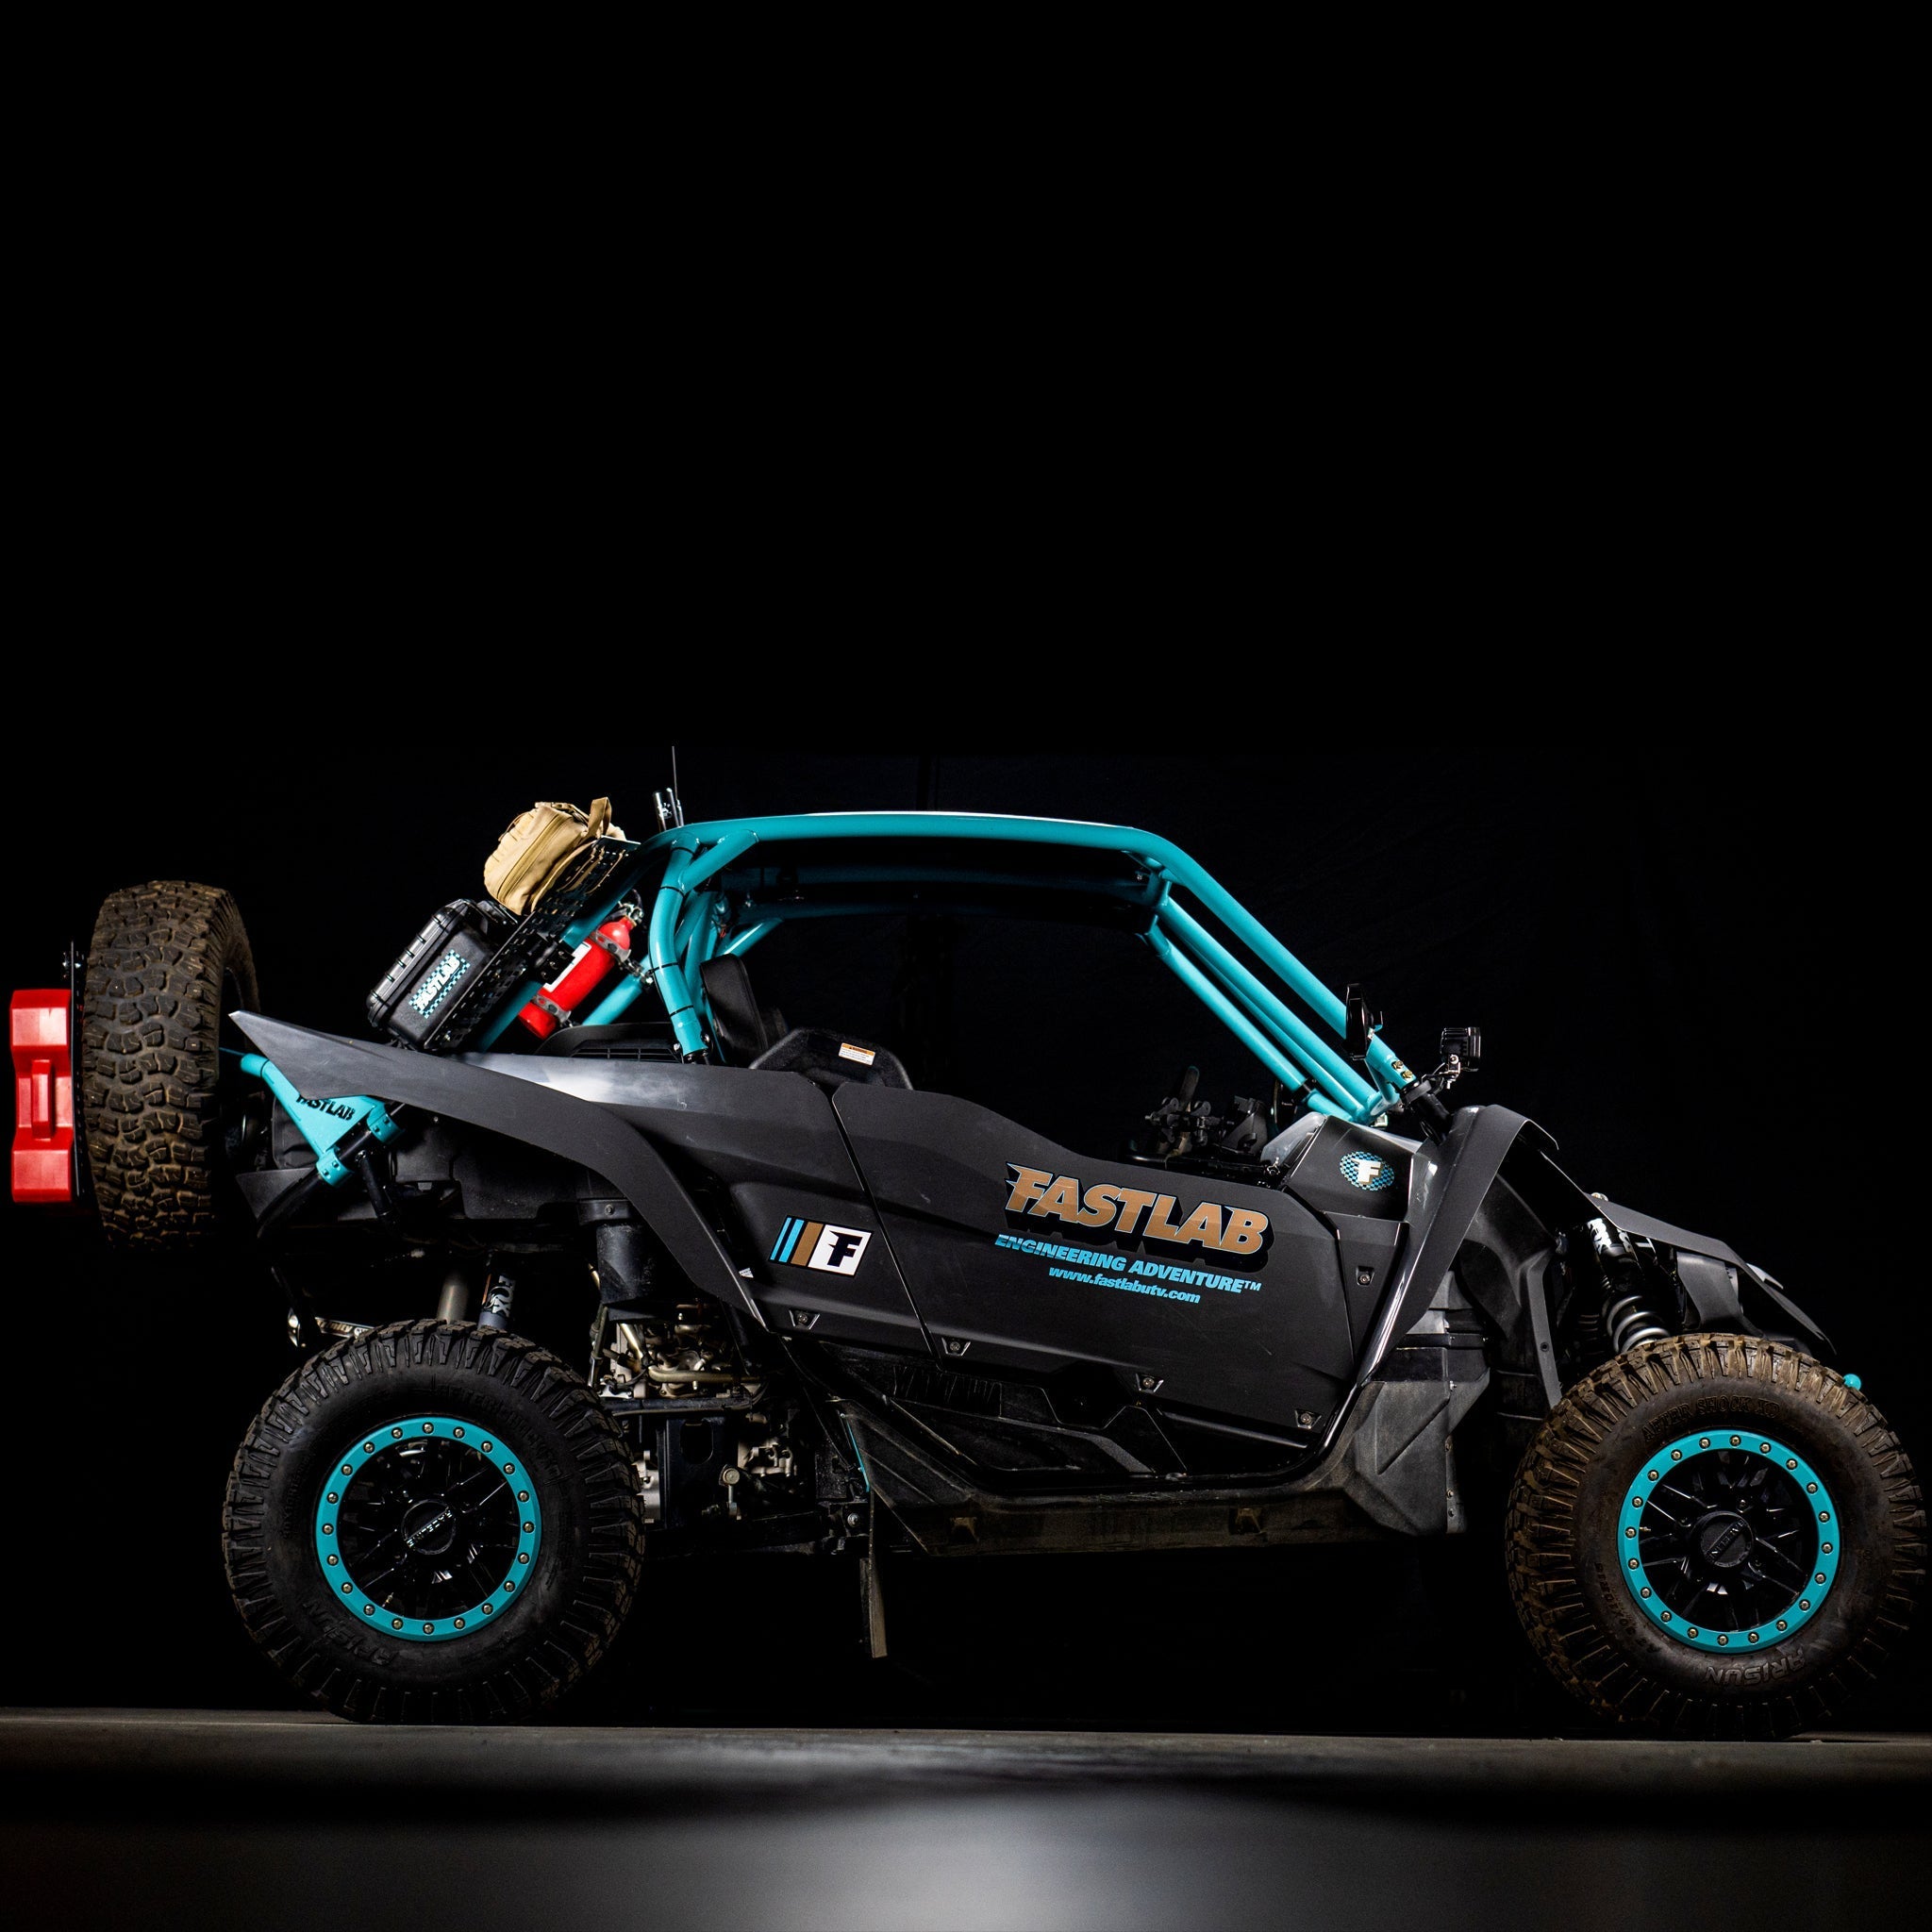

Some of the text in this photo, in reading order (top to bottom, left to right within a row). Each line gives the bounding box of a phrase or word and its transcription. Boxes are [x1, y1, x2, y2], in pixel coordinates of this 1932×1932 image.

[413, 955, 460, 1009] FASTLAB
[1350, 1158, 1382, 1183] F
[1004, 1161, 1272, 1260] FASTLAB
[827, 1230, 863, 1268] F
[993, 1233, 1127, 1272] ENGINEERING
[488, 1274, 516, 1319] FOX
[1048, 1267, 1201, 1304] www.fastlabutv.com
[1641, 1403, 1693, 1441] AFTER
[1696, 1395, 1752, 1415] SHOCK
[1704, 1646, 1807, 1687] ARISUN
